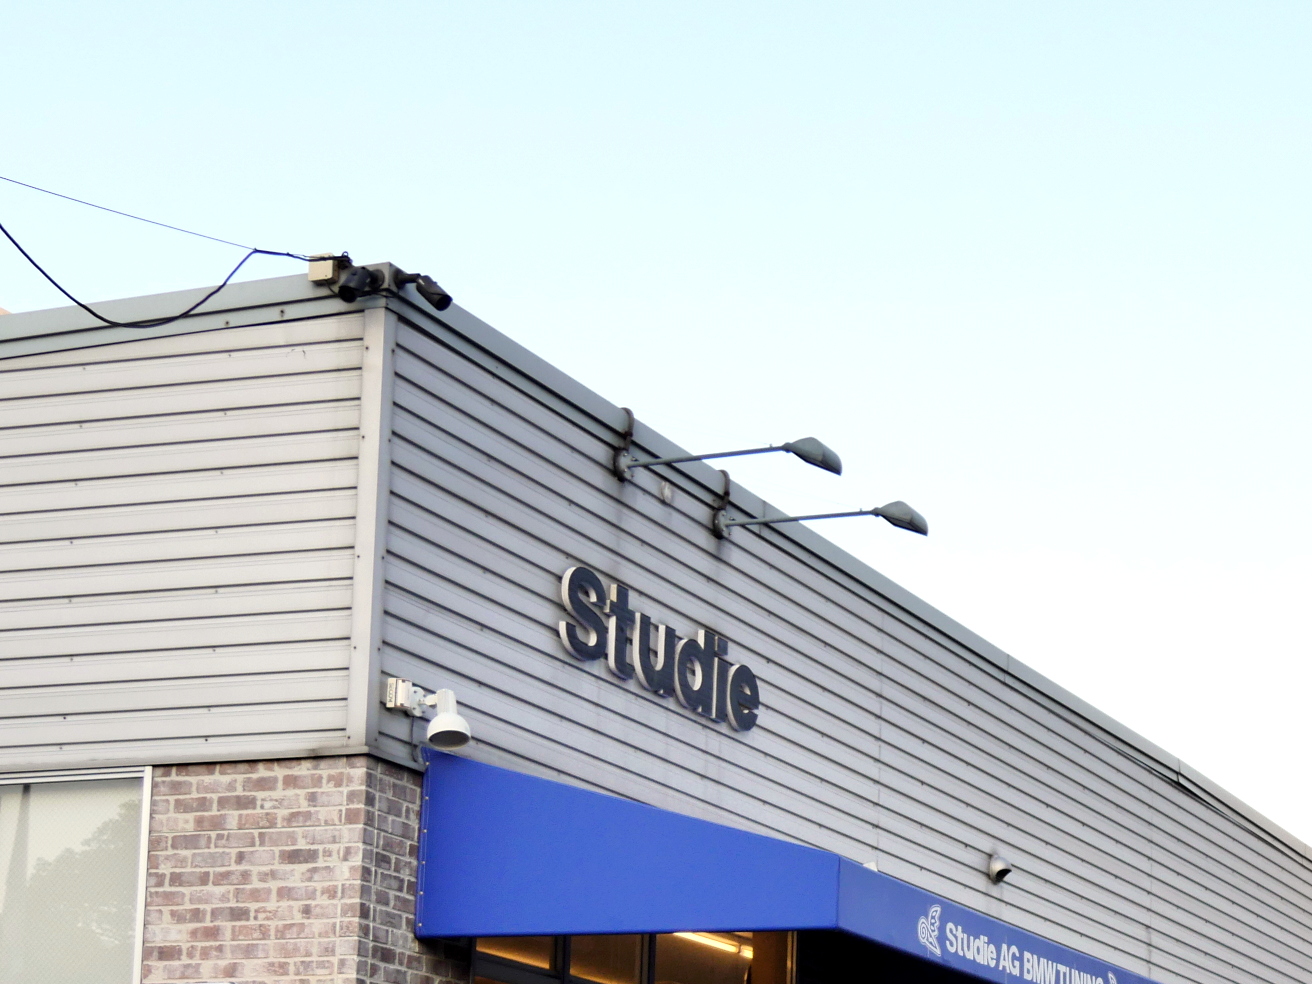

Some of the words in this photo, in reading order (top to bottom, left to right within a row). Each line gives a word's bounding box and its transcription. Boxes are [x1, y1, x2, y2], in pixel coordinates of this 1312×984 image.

[559, 566, 760, 732] Studie
[945, 922, 997, 968] Studie
[999, 943, 1020, 977] AG
